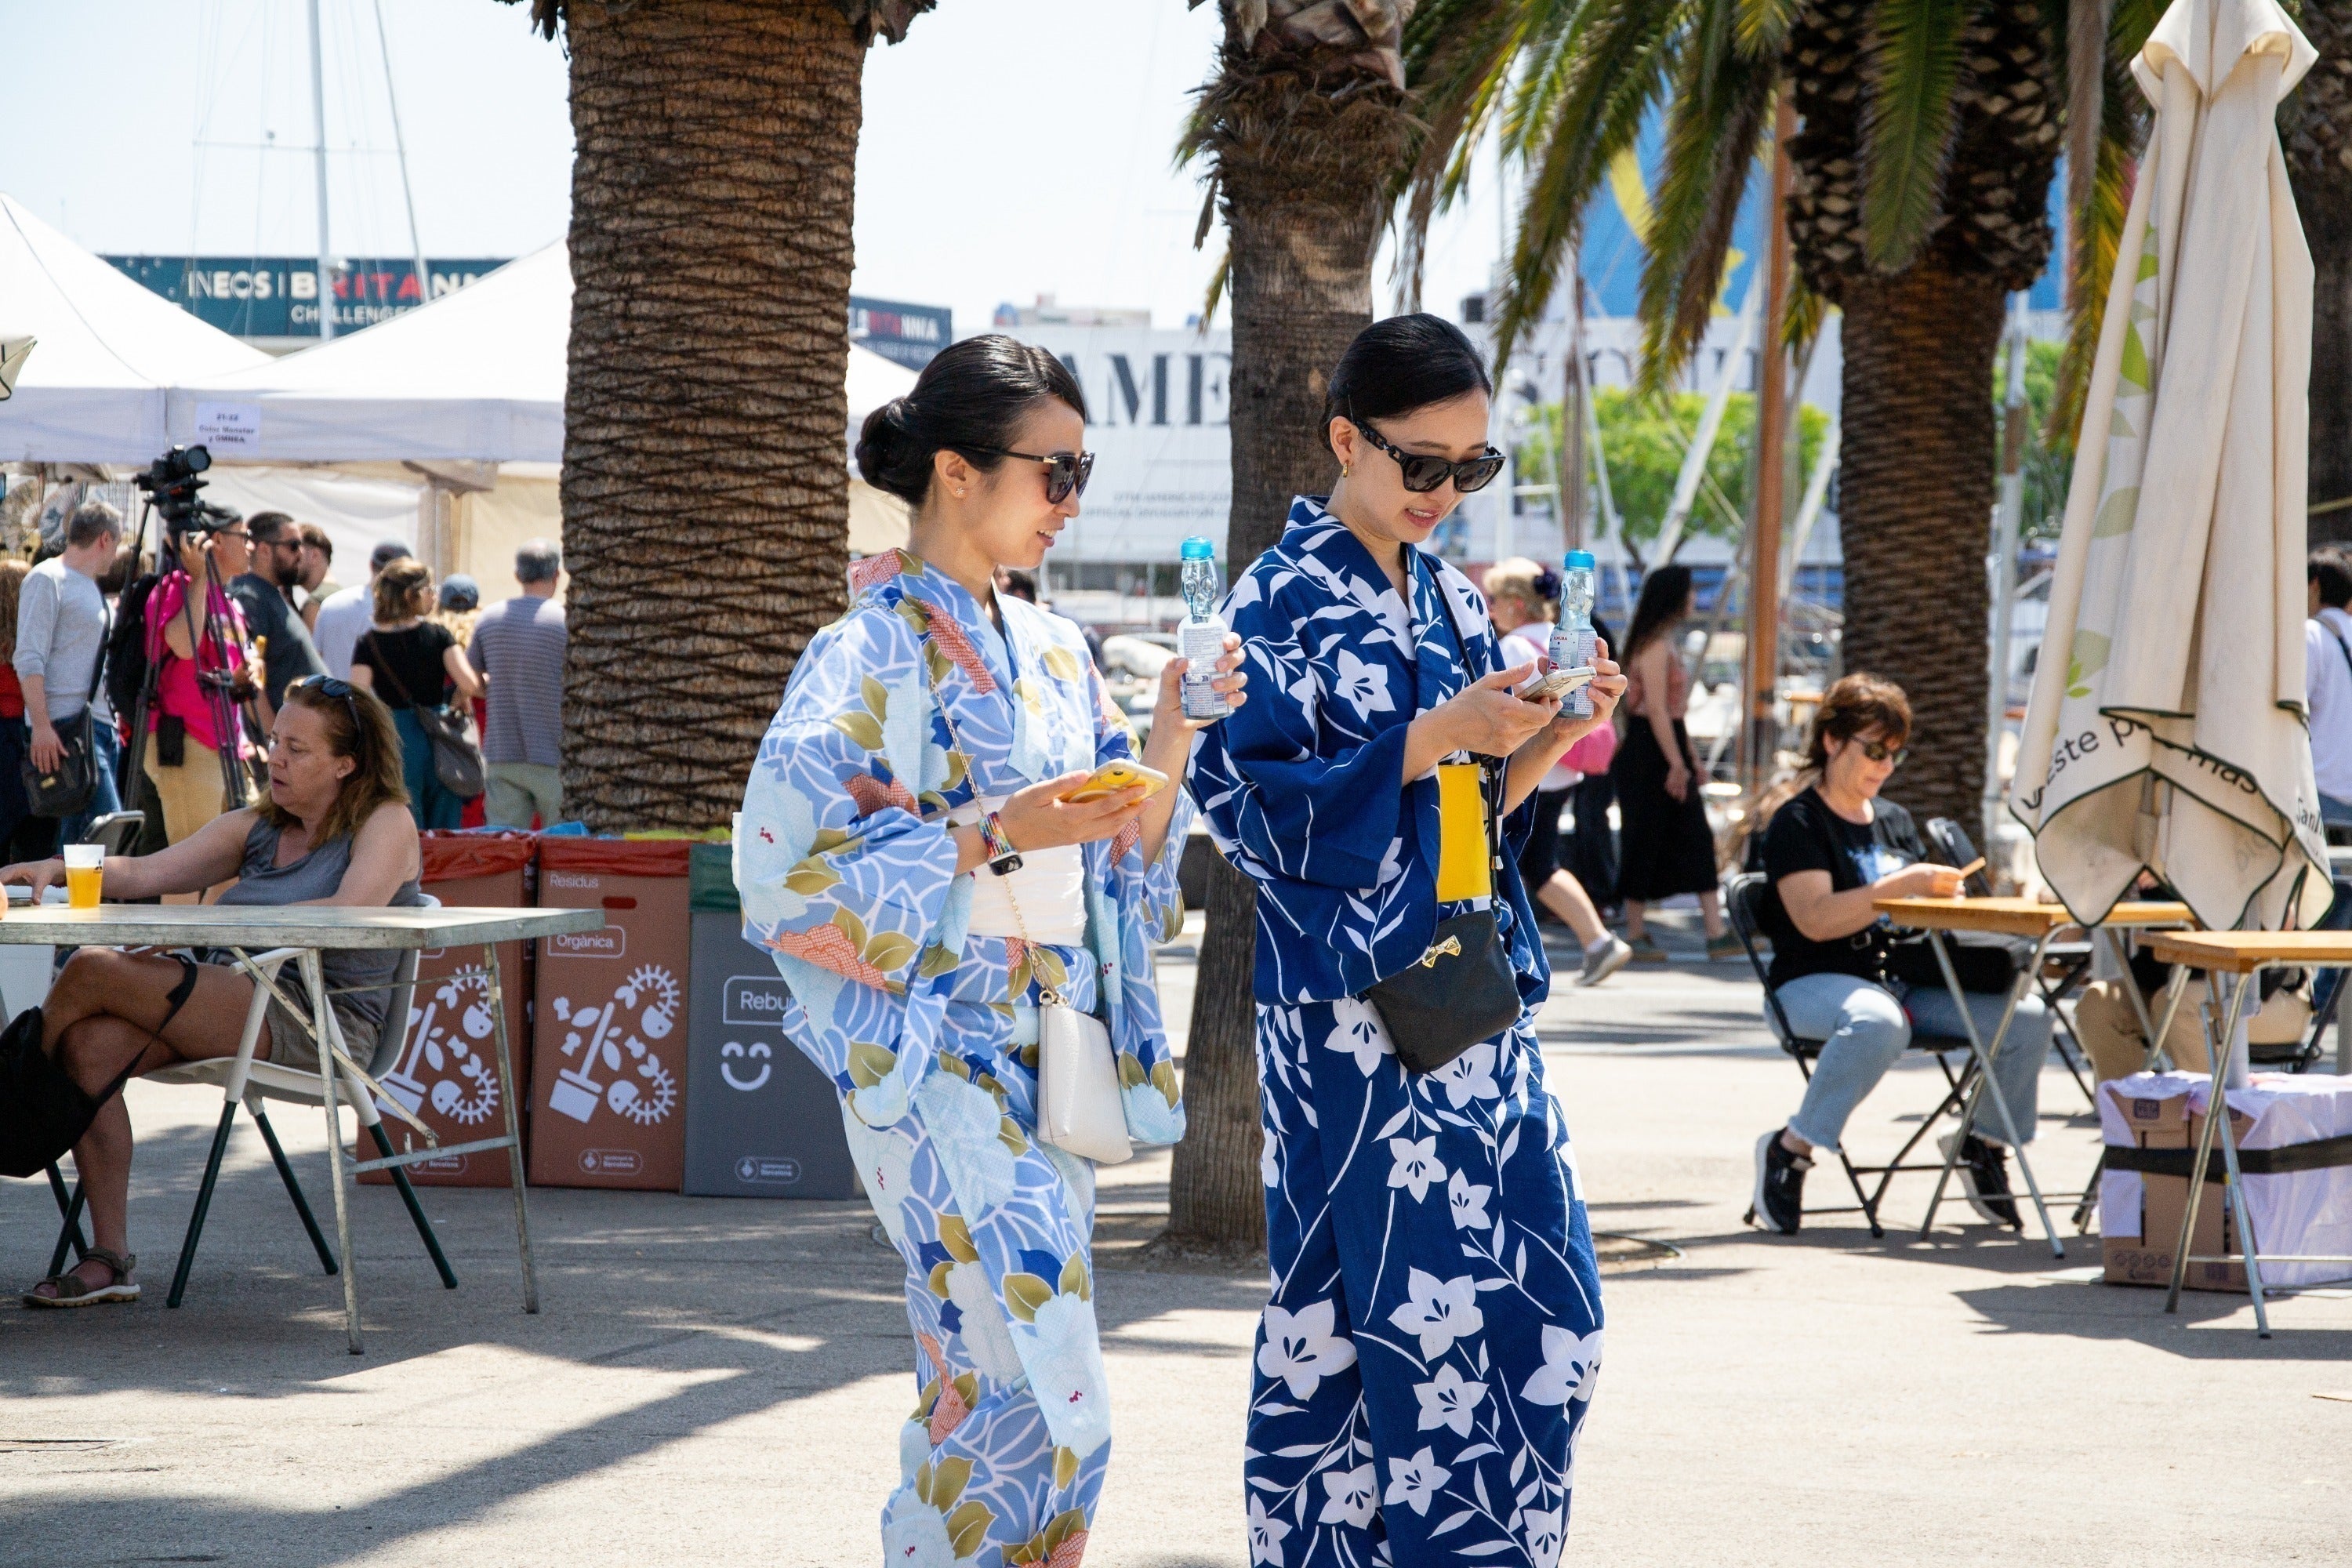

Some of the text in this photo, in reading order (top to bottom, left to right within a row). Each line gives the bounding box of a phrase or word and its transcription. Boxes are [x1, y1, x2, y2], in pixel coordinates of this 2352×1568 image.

[187, 270, 273, 299] INEOS
[550, 874, 599, 889] Residus
[557, 932, 614, 951] Orgànica
